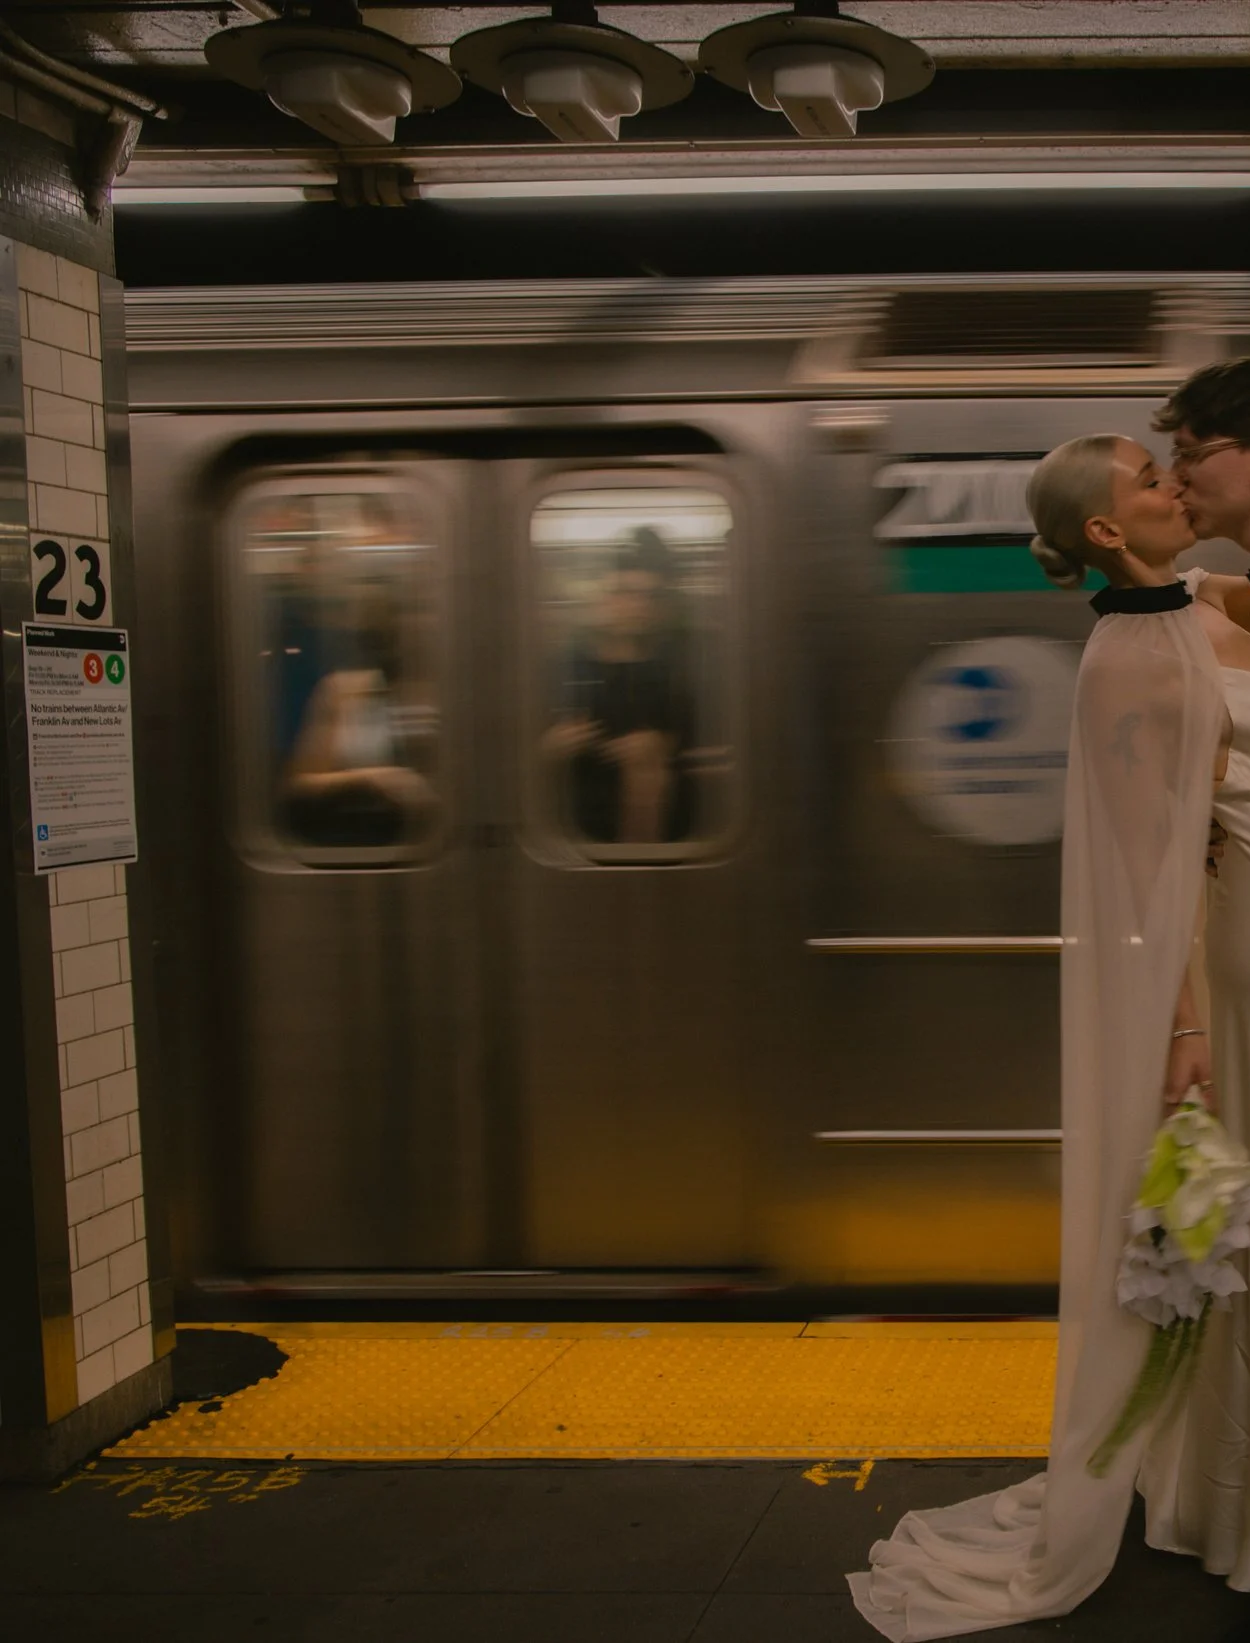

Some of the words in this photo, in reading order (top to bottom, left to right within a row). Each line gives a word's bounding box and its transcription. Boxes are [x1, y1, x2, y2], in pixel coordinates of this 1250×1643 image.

[33, 540, 106, 620] 23
[60, 651, 77, 659] Nights
[89, 659, 98, 677] 3
[111, 660, 119, 678] 4
[31, 704, 41, 713] No
[42, 704, 62, 713] trains
[64, 704, 92, 713] between
[94, 704, 116, 713] Atlantic
[32, 717, 60, 726] Franklin
[61, 717, 69, 726] Av
[70, 717, 83, 726] and
[84, 717, 98, 725] New
[100, 716, 113, 725] Lots
[113, 716, 122, 725] Av
